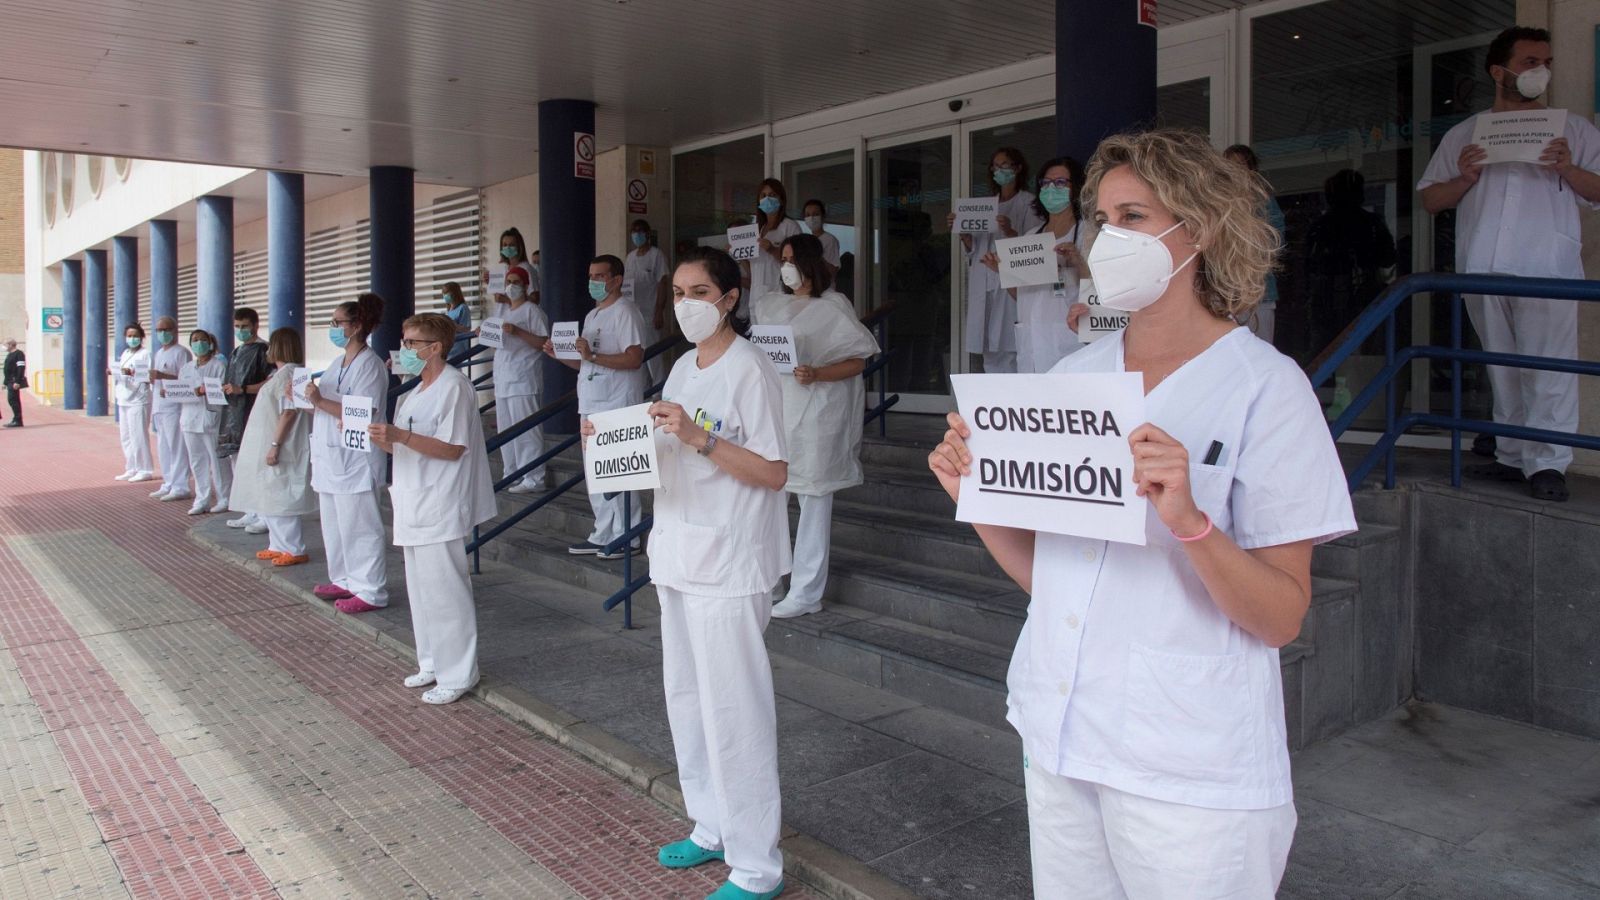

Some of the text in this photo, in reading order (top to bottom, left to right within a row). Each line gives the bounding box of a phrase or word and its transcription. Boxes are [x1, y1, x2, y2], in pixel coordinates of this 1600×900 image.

[958, 204, 994, 213] CONSEJERA
[960, 219, 988, 231] CESE
[731, 233, 756, 241] CONSEJERA
[733, 246, 755, 260] CESE
[1009, 243, 1044, 255] VENTURA
[1010, 257, 1045, 269] DIMISION
[752, 335, 789, 344] ONSEJERA
[344, 407, 368, 418] CONSEJERA
[974, 406, 1122, 437] CONSEJERA
[344, 429, 366, 450] CESE
[596, 424, 649, 446] CONSEJERA
[594, 451, 650, 476] DIMISIÓN
[979, 457, 1122, 498] DIMISIÓN
